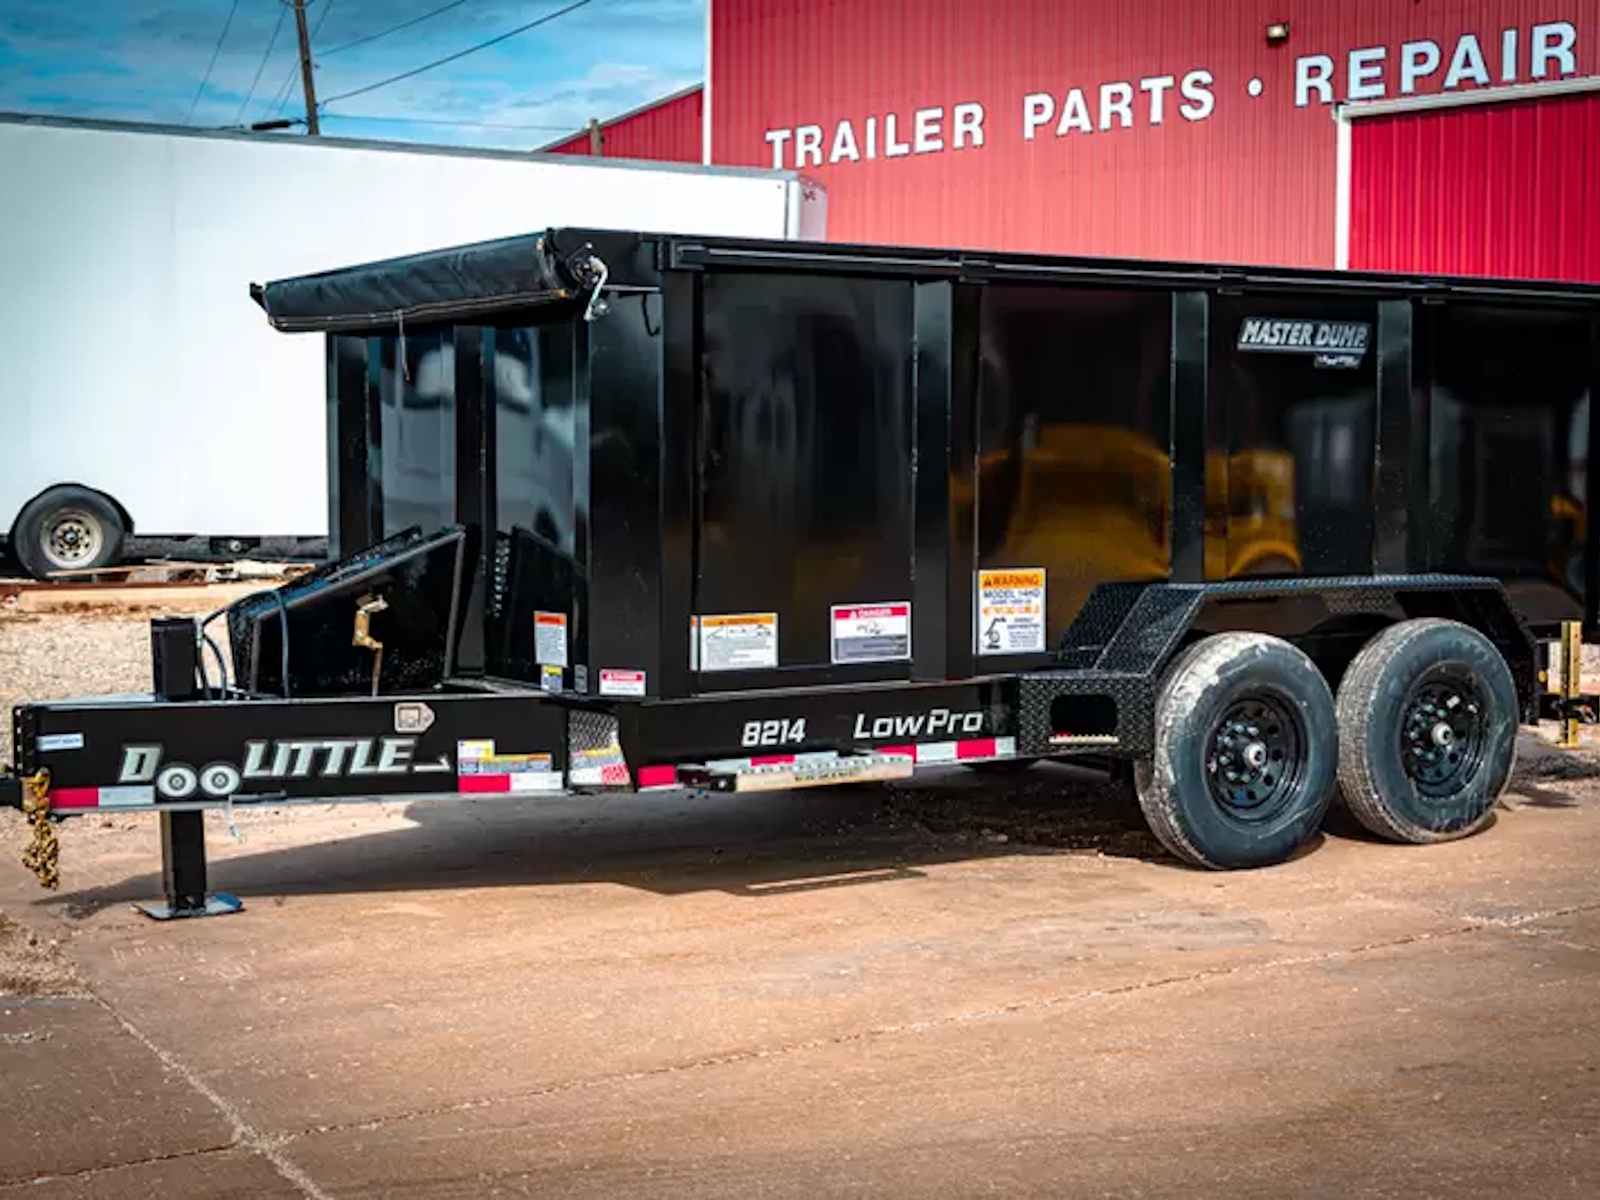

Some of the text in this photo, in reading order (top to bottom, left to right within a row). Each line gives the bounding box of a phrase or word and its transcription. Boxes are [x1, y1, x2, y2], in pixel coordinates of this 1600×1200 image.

[765, 20, 1579, 170] TRAILER PARTS REPAIR
[1241, 319, 1314, 346] MASTER
[741, 718, 807, 748] 8214
